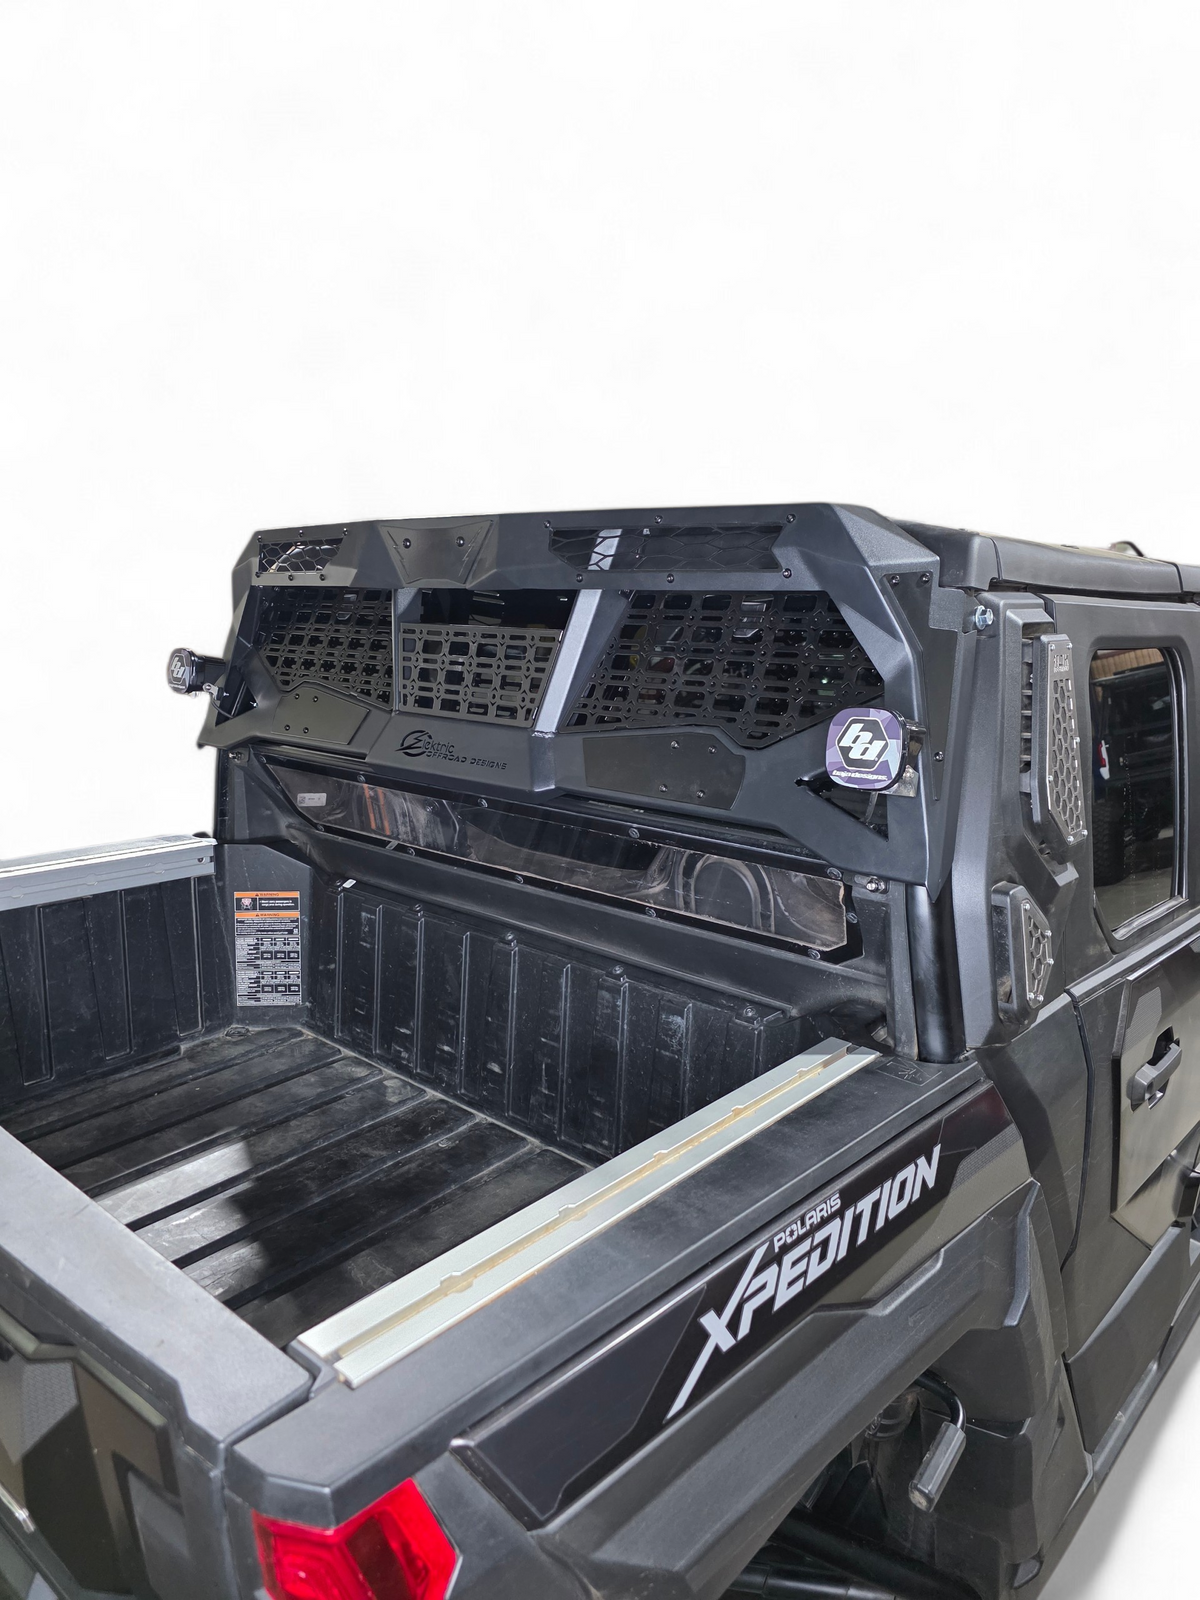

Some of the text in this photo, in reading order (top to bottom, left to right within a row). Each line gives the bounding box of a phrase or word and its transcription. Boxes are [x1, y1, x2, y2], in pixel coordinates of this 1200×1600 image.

[426, 751, 507, 770] OFFROAD DESIGNS
[839, 723, 887, 761] bd
[832, 769, 851, 778] baja
[773, 1192, 842, 1252] POLARIS
[663, 1143, 941, 1424] XPEDITION
